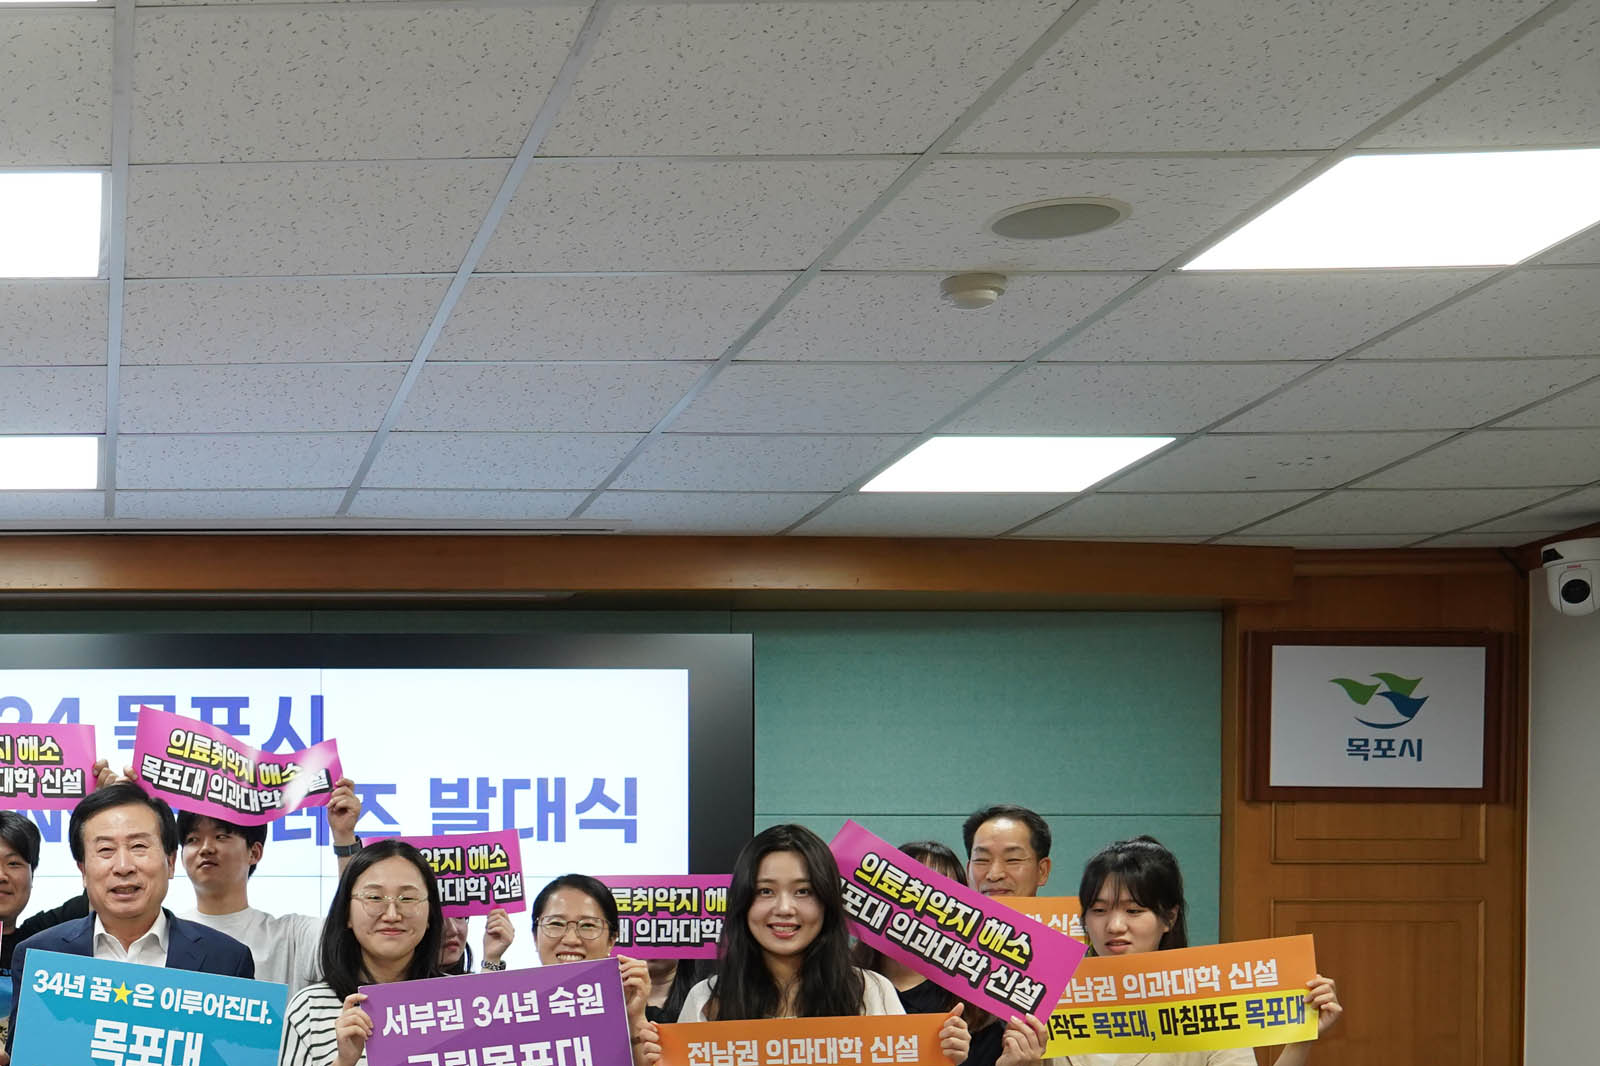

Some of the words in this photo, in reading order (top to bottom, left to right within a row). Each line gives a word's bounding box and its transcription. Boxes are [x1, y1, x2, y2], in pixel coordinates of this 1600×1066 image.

[16, 735, 61, 762] 해소
[166, 728, 255, 784] 의료취약지
[1346, 737, 1423, 762] 목포시
[40, 768, 83, 795] 신설
[141, 754, 207, 796] 목포대
[208, 773, 282, 813] 의과대학
[430, 777, 637, 844] 발대식
[467, 844, 508, 871] 해소
[492, 872, 523, 900] 신설
[609, 887, 698, 912] 료취약지
[855, 852, 982, 938] 의료취약지
[977, 916, 1032, 965] 해소
[841, 878, 891, 930] 포대
[886, 912, 989, 983] 의과대학
[985, 964, 1045, 1012] 신설
[32, 969, 86, 999] 34년
[160, 987, 273, 1025] 이루어진다.
[1122, 964, 1221, 999] 의과대학
[1228, 958, 1279, 990] 신설
[382, 998, 465, 1037] 서부권
[472, 990, 541, 1028] 34년
[549, 983, 605, 1017] 숙원
[1093, 1010, 1156, 1041] 목포대,
[1158, 1001, 1241, 1037] 마침표도
[1245, 995, 1305, 1029] 목포대
[766, 1036, 863, 1066] 의과대학
[869, 1034, 920, 1063] 신설
